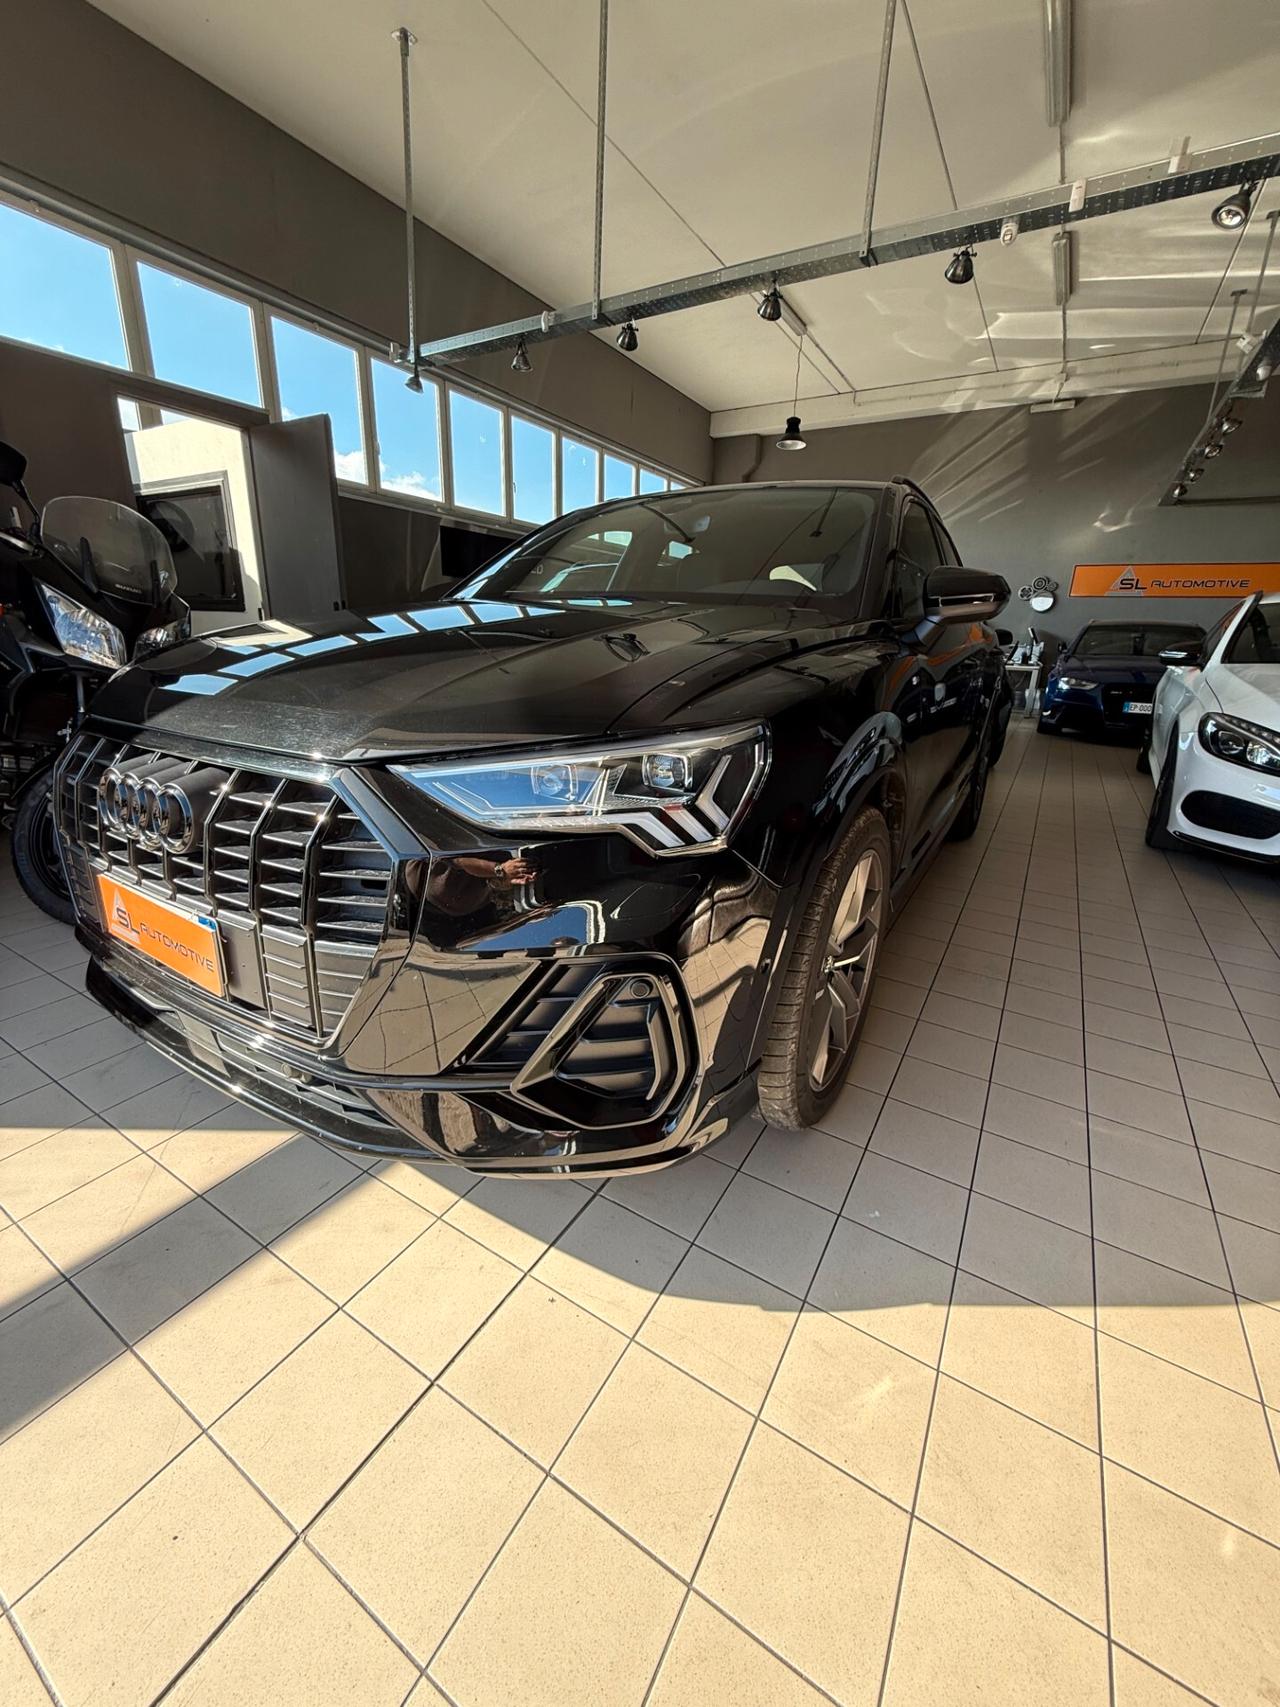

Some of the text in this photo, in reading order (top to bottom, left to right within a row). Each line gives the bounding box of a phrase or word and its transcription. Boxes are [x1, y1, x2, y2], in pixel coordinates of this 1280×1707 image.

[1119, 578, 1250, 590] SL AUTOMOTIVE
[116, 907, 215, 973] SL AUTOMOTIVE
